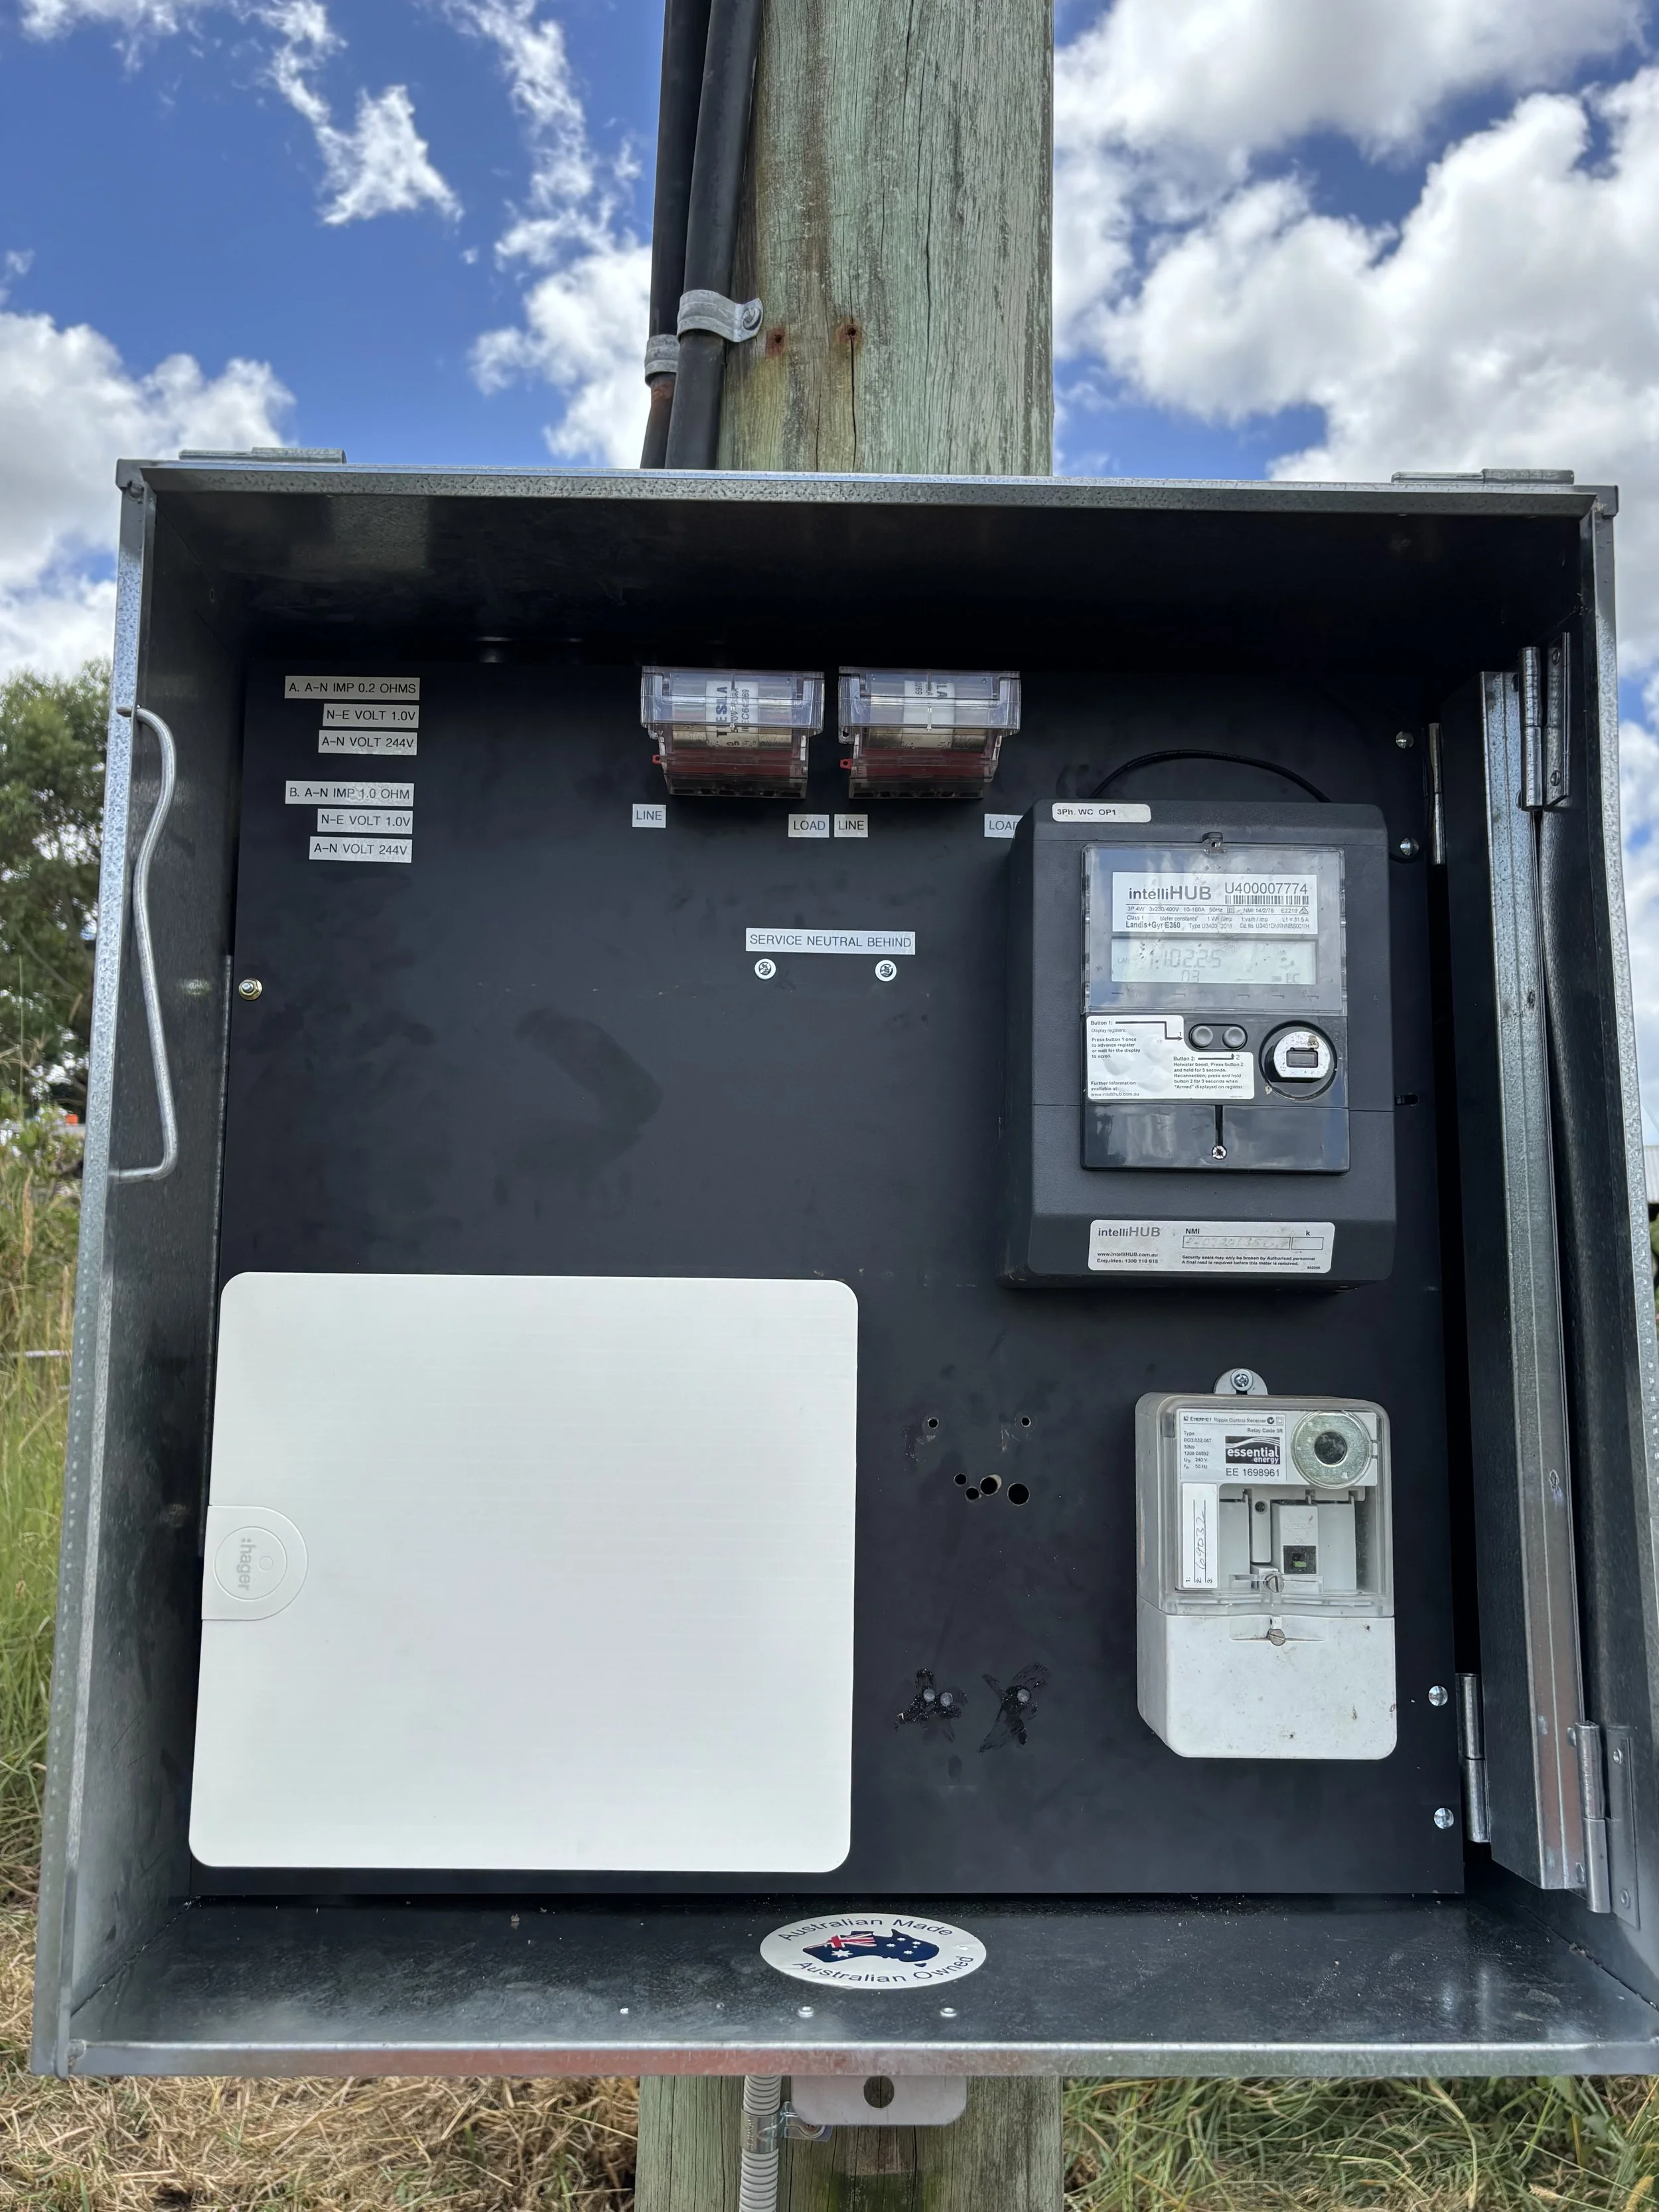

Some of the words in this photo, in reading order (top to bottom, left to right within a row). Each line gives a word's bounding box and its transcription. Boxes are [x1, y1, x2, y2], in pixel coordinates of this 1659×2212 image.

[289, 683, 299, 692] A.
[305, 683, 327, 692] A-N
[333, 683, 354, 693] IMP
[358, 684, 375, 693] 0.2
[380, 684, 416, 694] OHMS
[327, 710, 349, 719] N-E
[355, 710, 386, 720] VOLT
[392, 711, 415, 721] 1.0V
[322, 737, 344, 746] A-N
[350, 737, 381, 747] VOLT
[386, 738, 414, 748] 244V
[290, 787, 300, 797] B.
[305, 788, 328, 797] A-N
[333, 788, 355, 797] IMP
[360, 789, 375, 798] 1.0
[381, 790, 409, 799] OHM
[322, 815, 344, 824] N-E
[349, 815, 381, 825] VOLT
[386, 817, 410, 826] 1.0V
[636, 810, 663, 820] LINE
[794, 820, 826, 830] LOAD
[838, 820, 864, 830] LINE
[314, 843, 337, 852] A-N
[343, 844, 374, 854] VOLT
[379, 845, 407, 855] 244V
[1129, 886, 1211, 900] intelliHUB
[1225, 882, 1307, 894] U400007774
[1126, 921, 1163, 929] Landis+Gyr
[750, 935, 802, 945] SERVICE
[807, 936, 862, 946] NEUTRAL
[867, 937, 911, 947] BEHIND
[1098, 1226, 1160, 1237] intelliHUB
[1227, 1446, 1279, 1457] essential
[1243, 1469, 1279, 1477] 1698961
[778, 1918, 883, 1941] Australian
[893, 1919, 953, 1936] Made
[792, 1960, 906, 1983] Australian
[913, 1955, 974, 1980] Owned
